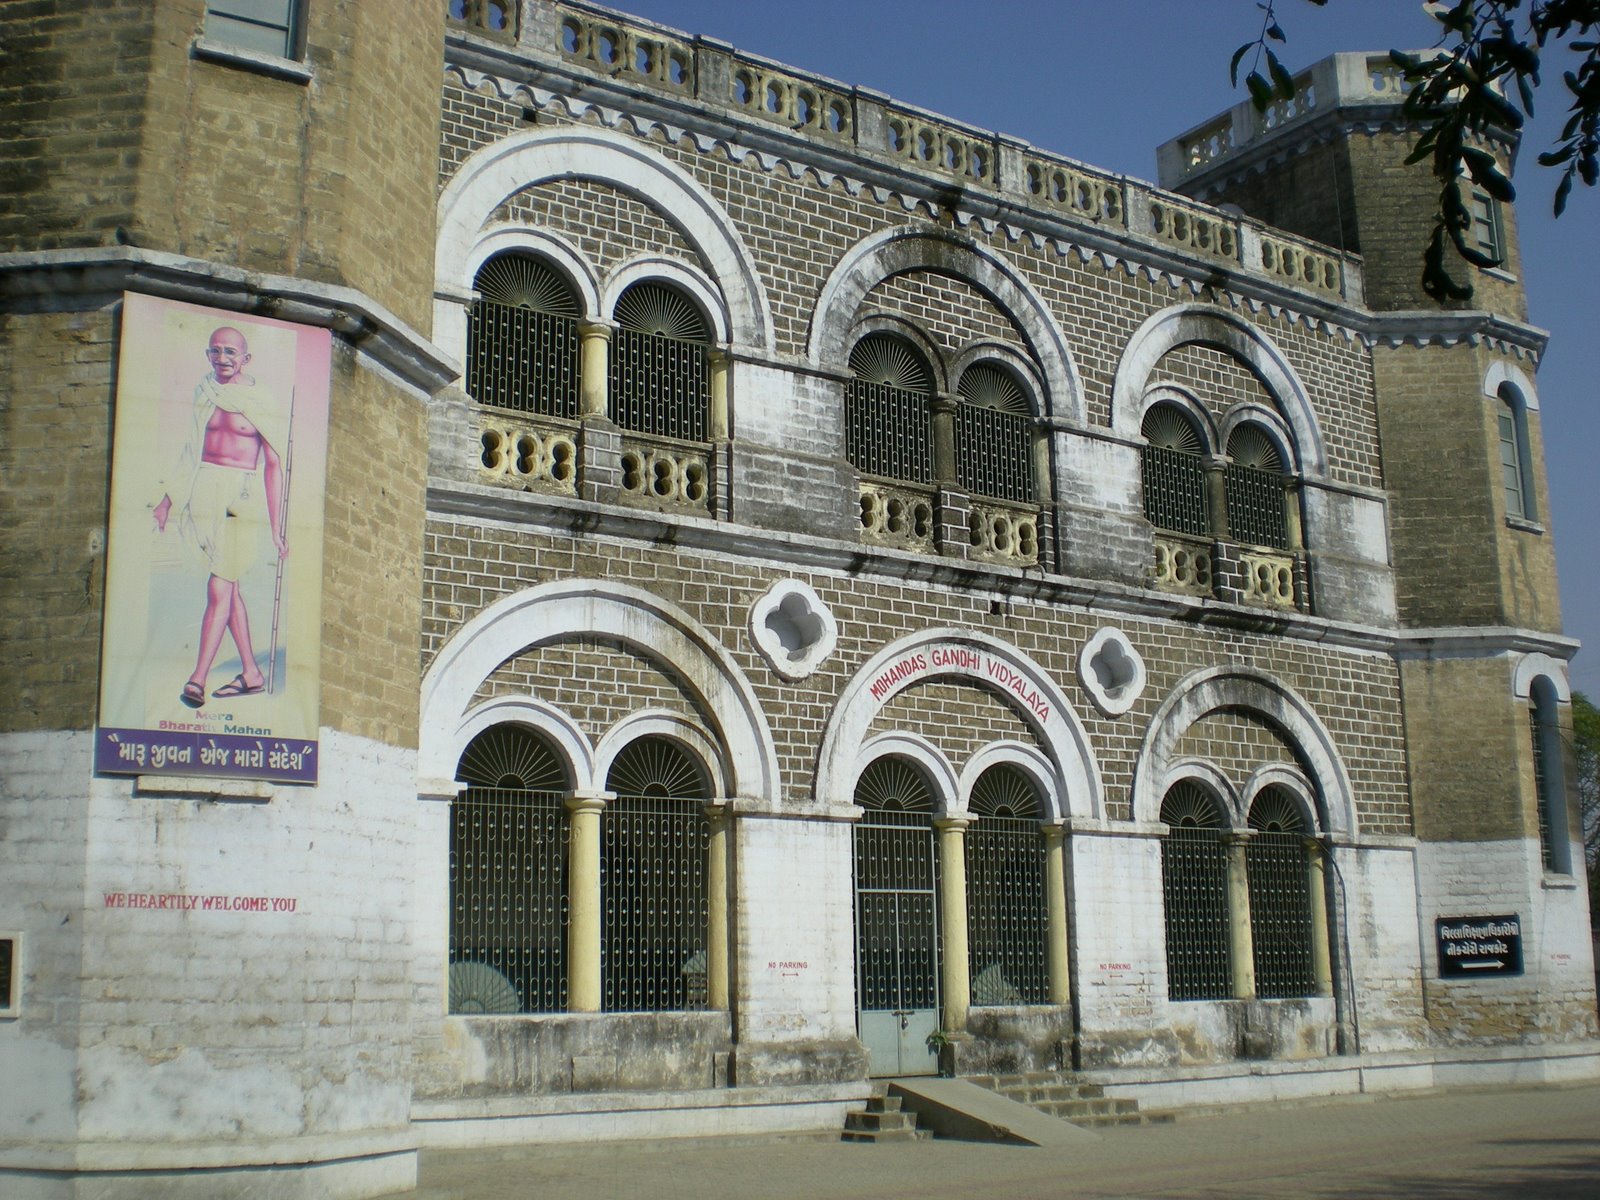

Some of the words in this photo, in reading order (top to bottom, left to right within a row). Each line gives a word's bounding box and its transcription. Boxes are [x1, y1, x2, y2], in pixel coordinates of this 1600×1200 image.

[870, 653, 927, 701] MOHANDAS
[932, 650, 981, 670] GANDHI
[986, 658, 1050, 723] VIDYALAYA
[195, 710, 233, 721] Mera
[224, 724, 271, 736] Mahan
[151, 744, 192, 769] જીવન
[234, 741, 264, 768] મારો
[103, 893, 125, 908] WE
[127, 894, 200, 910] HEARTILY
[271, 898, 297, 912] YOU
[1479, 939, 1509, 955] રાજકોટ
